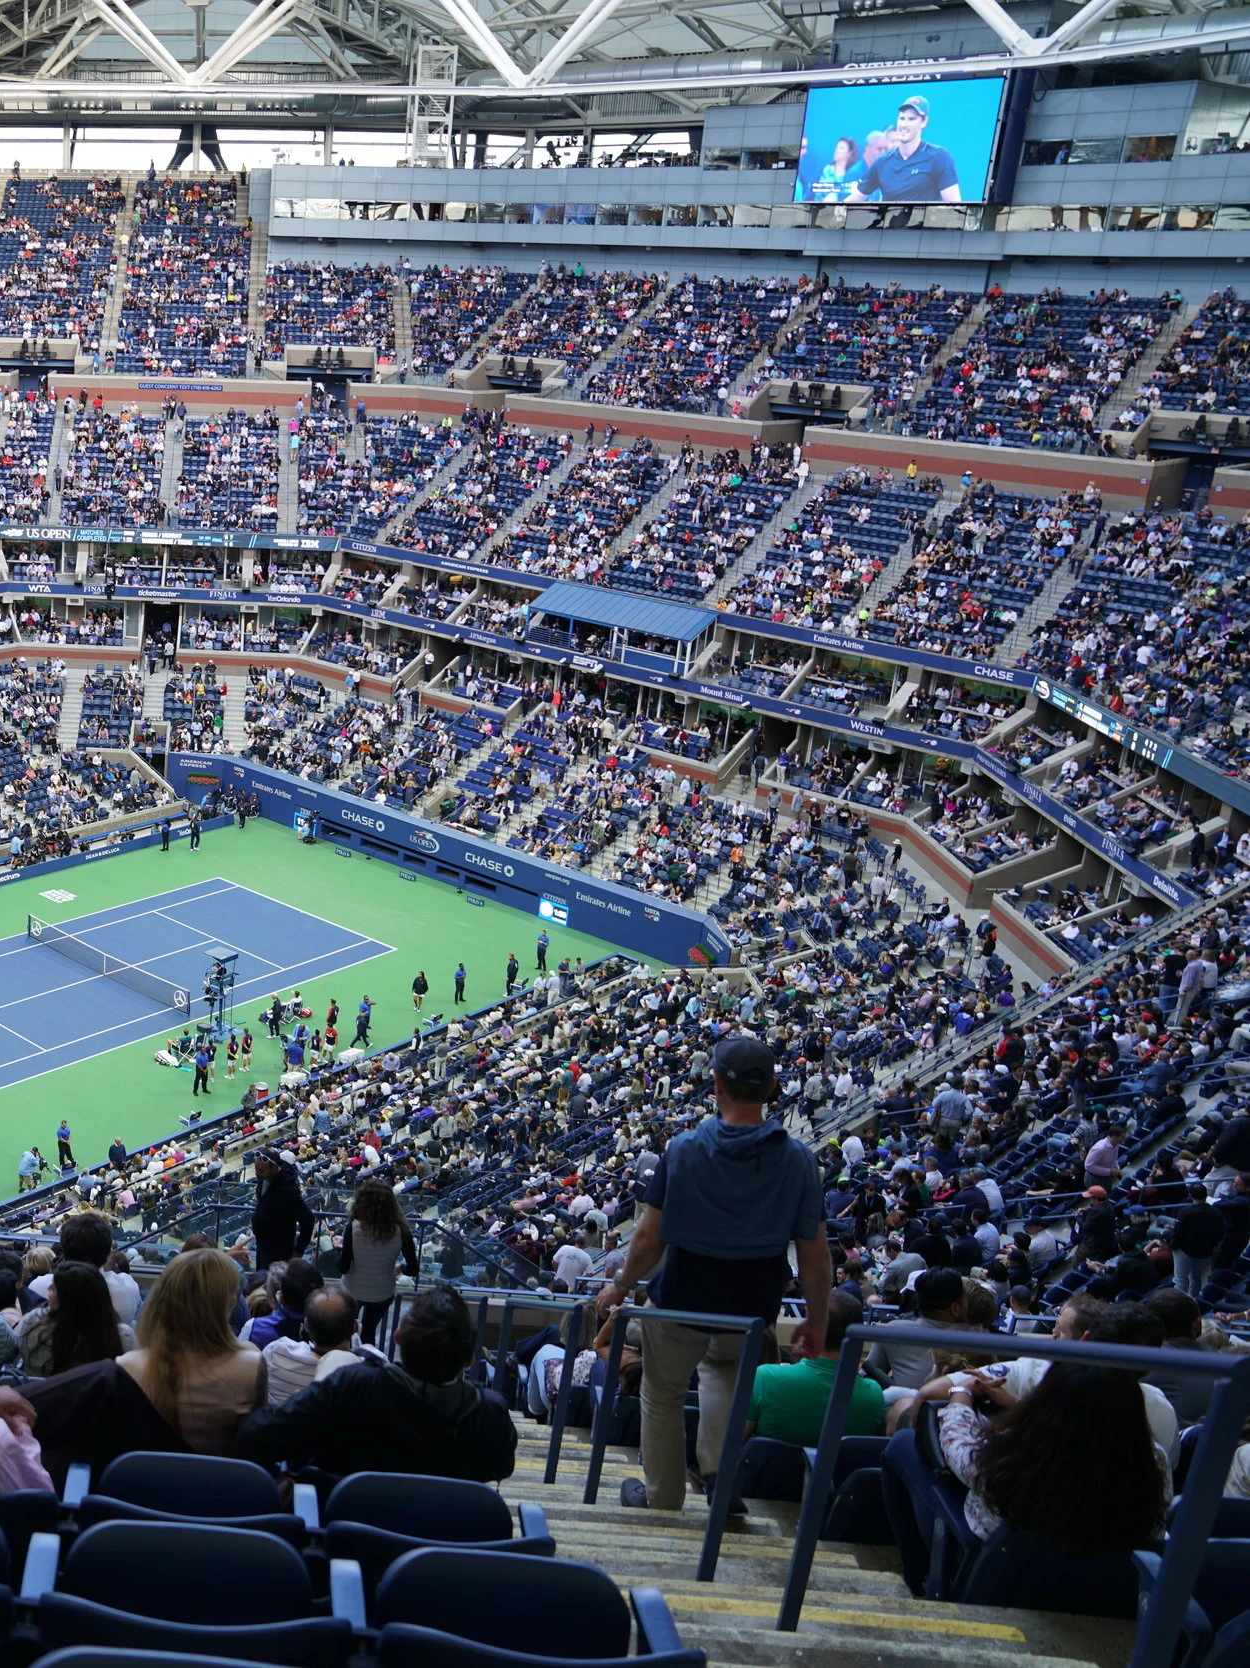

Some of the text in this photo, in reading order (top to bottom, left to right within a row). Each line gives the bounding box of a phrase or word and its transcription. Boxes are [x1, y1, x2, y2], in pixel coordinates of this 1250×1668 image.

[26, 528, 72, 540] US OPEN
[301, 539, 319, 549] IBM
[352, 541, 377, 553] CITIZEN
[440, 560, 489, 574] AMERICAN EXPRESS
[28, 584, 52, 593] WTA
[138, 589, 179, 598] ticketmaster
[210, 590, 237, 599] FINALS
[370, 608, 386, 620] IBM
[813, 634, 865, 651] Emirates Airline
[974, 665, 1015, 682] CHASE
[700, 685, 743, 702] Mount Sinai
[850, 719, 885, 736] WESTIN
[180, 758, 213, 766] AMERICAN
[233, 765, 245, 774] USTA
[251, 780, 293, 800] Emirates Airline
[1023, 783, 1042, 803] FINALS
[341, 809, 374, 828] CHASE
[409, 836, 437, 850] US OPEN
[1102, 838, 1125, 861] FINALS
[464, 852, 502, 873] CHASE
[544, 872, 570, 886] usopen.org
[1152, 875, 1180, 902] Deloitte.
[543, 892, 567, 905] CITIZEN
[576, 891, 632, 917] Emirates Airline
[644, 906, 661, 917] USTA
